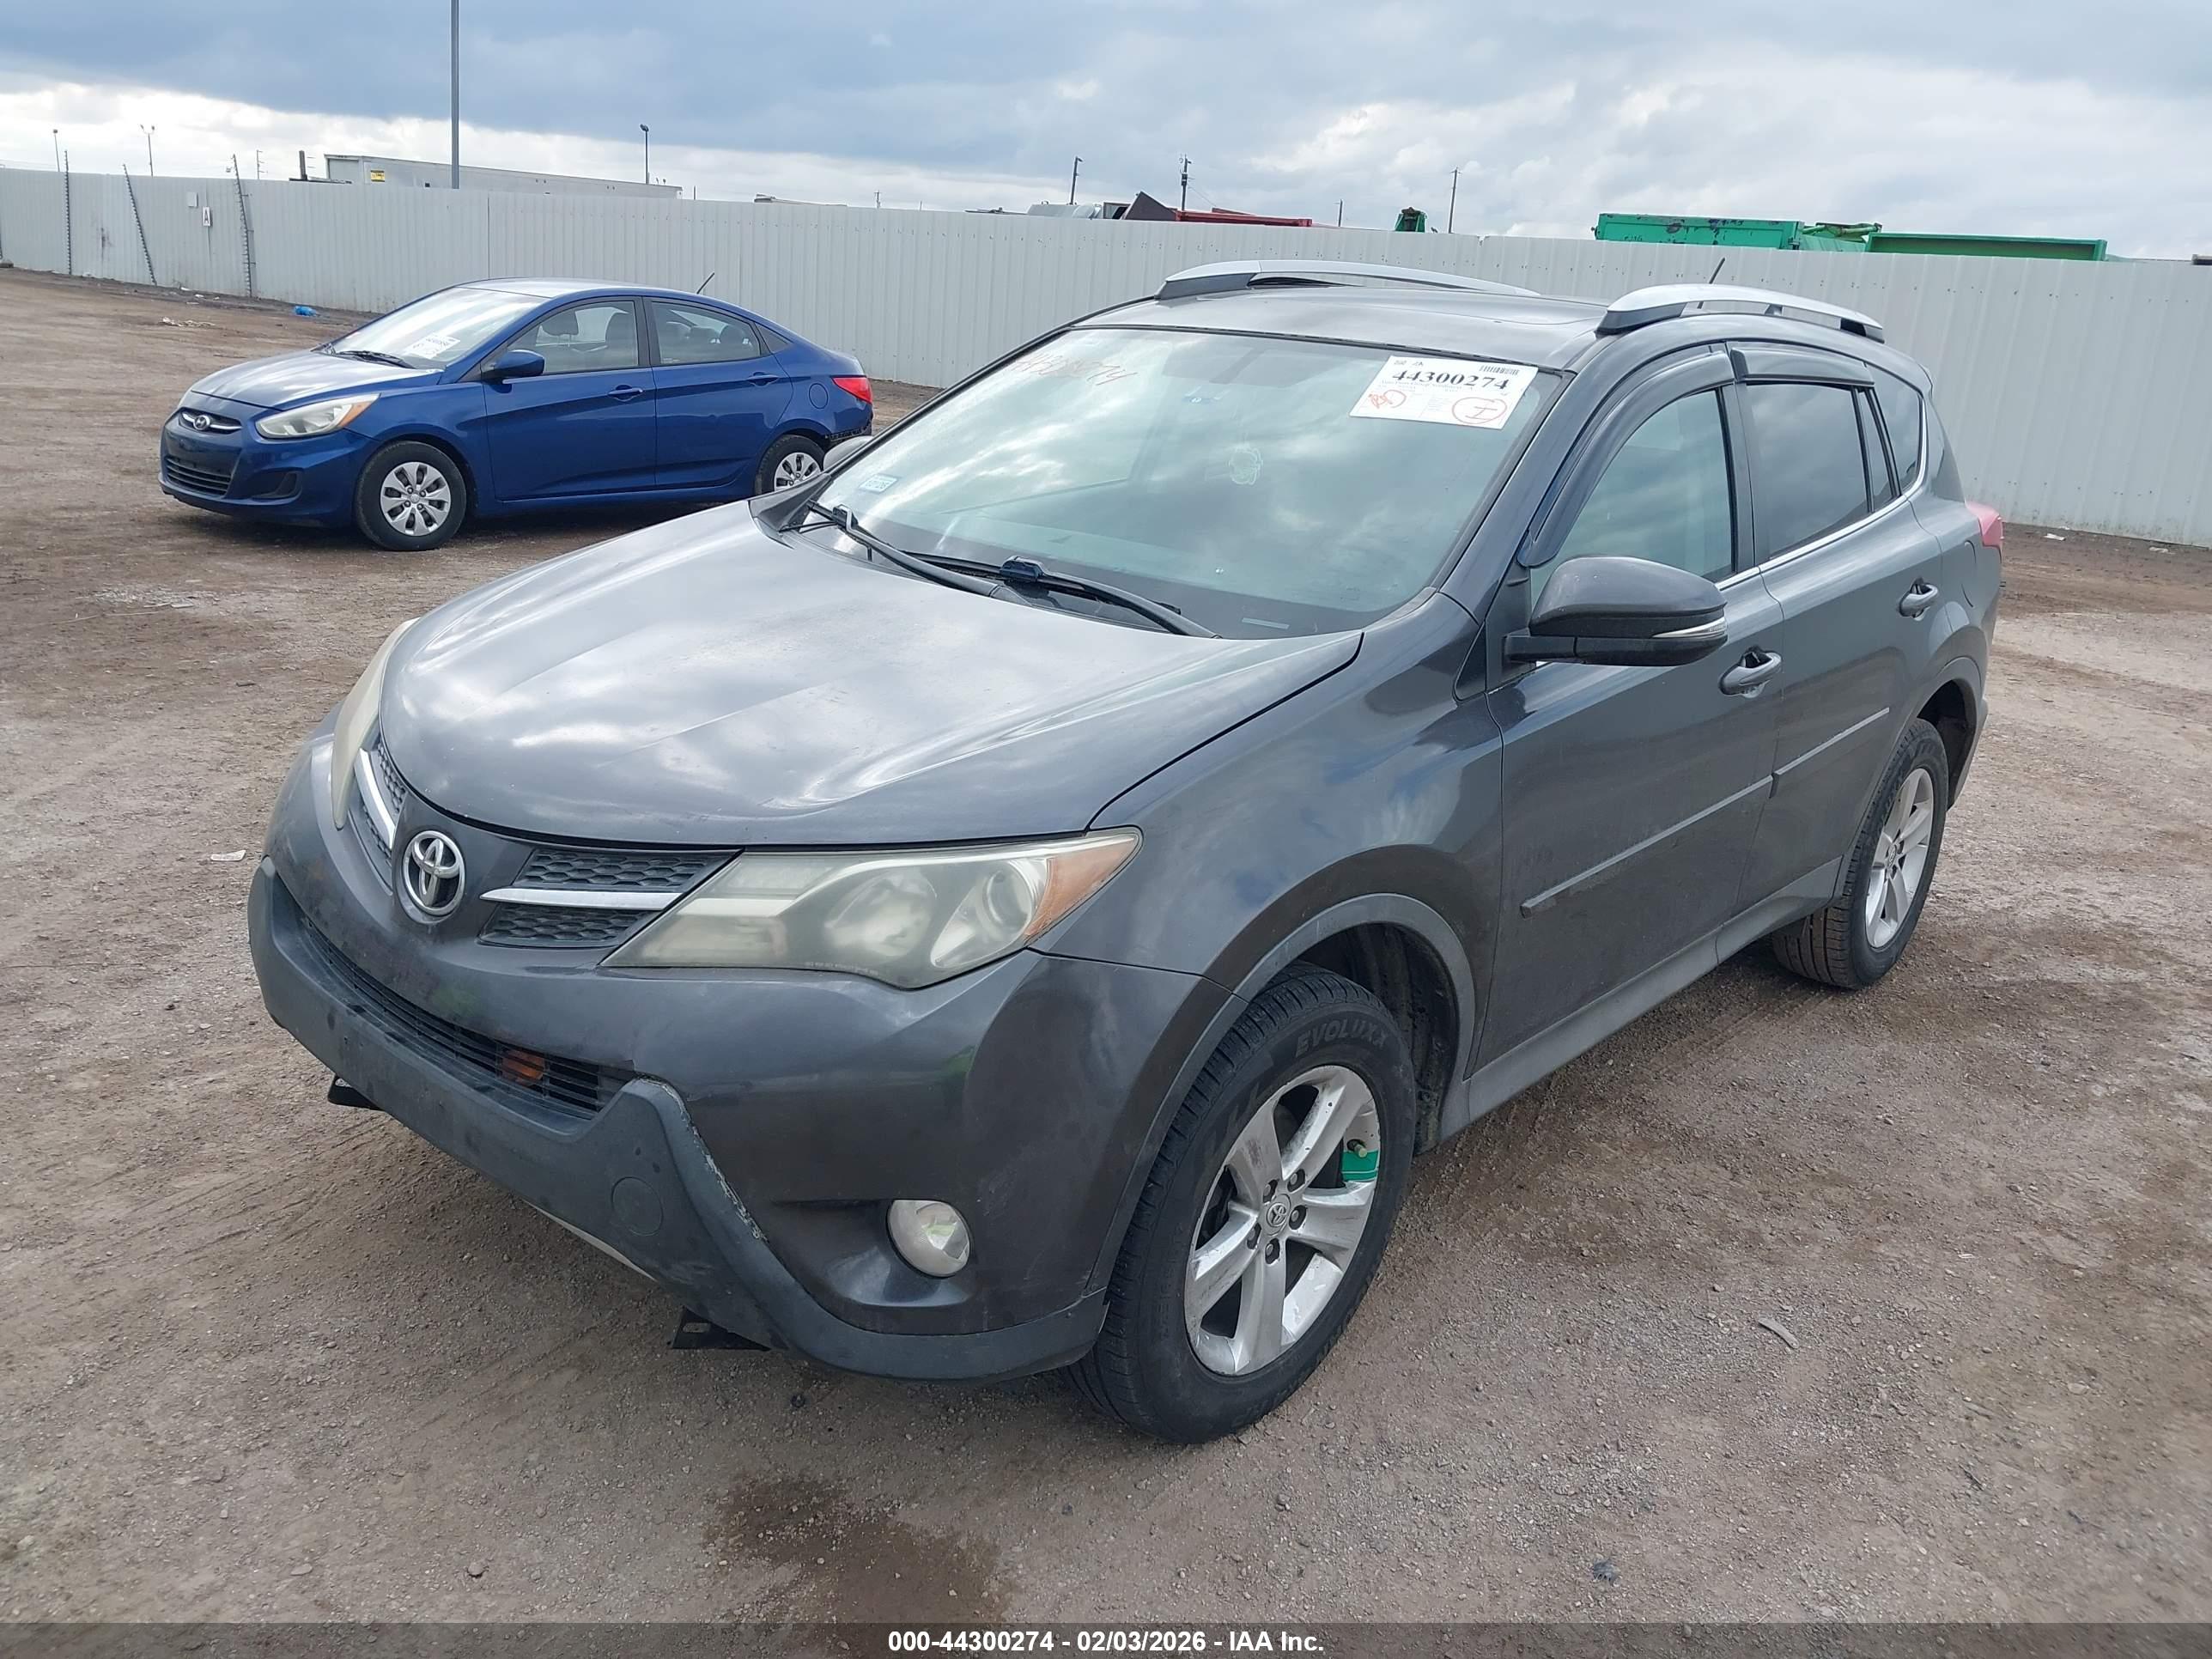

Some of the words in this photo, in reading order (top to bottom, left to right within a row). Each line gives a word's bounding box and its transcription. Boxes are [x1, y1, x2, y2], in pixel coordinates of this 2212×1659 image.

[204, 208, 210, 224] A
[1392, 369, 1510, 390] 44300274
[1295, 1018, 1389, 1058] EVOLUXX
